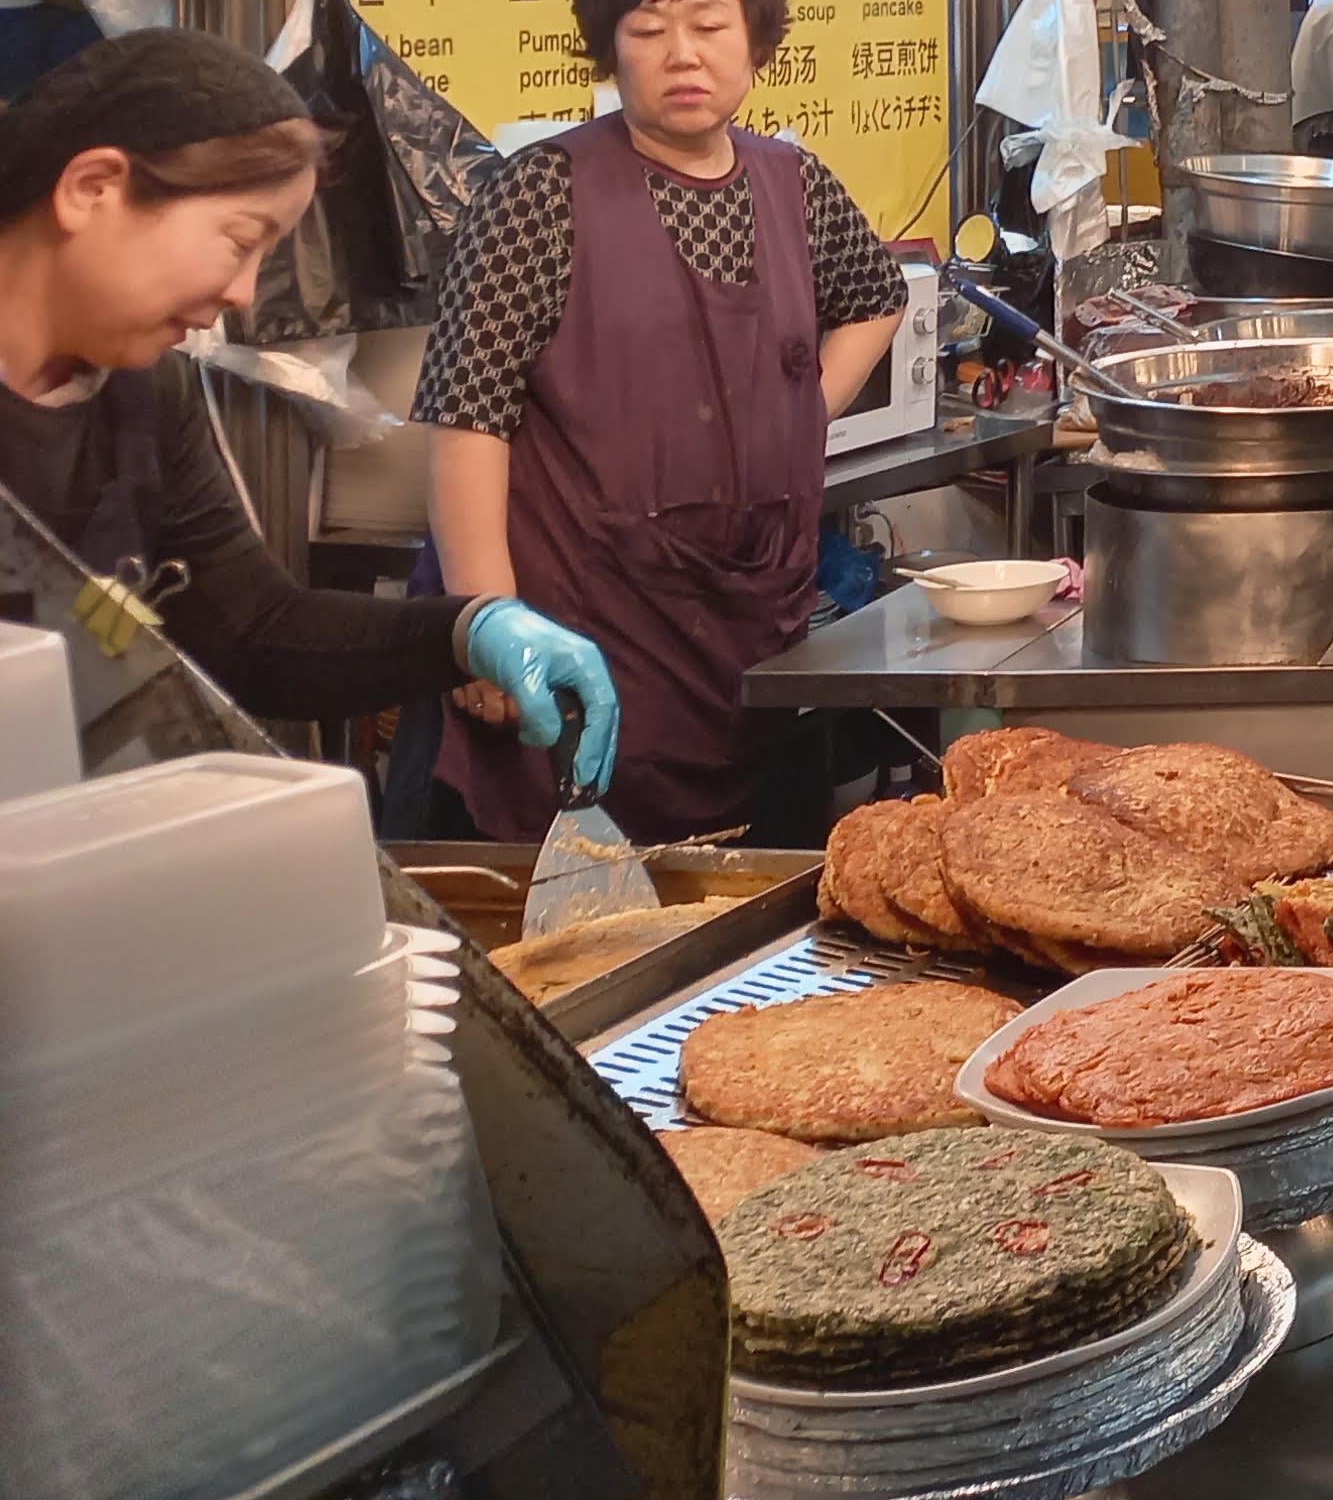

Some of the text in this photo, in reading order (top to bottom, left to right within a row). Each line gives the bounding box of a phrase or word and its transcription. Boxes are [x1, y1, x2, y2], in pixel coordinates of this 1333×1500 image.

[796, 4, 836, 25] soup
[862, 0, 924, 21] pancake
[399, 35, 454, 59] bean
[518, 29, 584, 54] Pumpk
[851, 37, 939, 80] 绿豆煎饼
